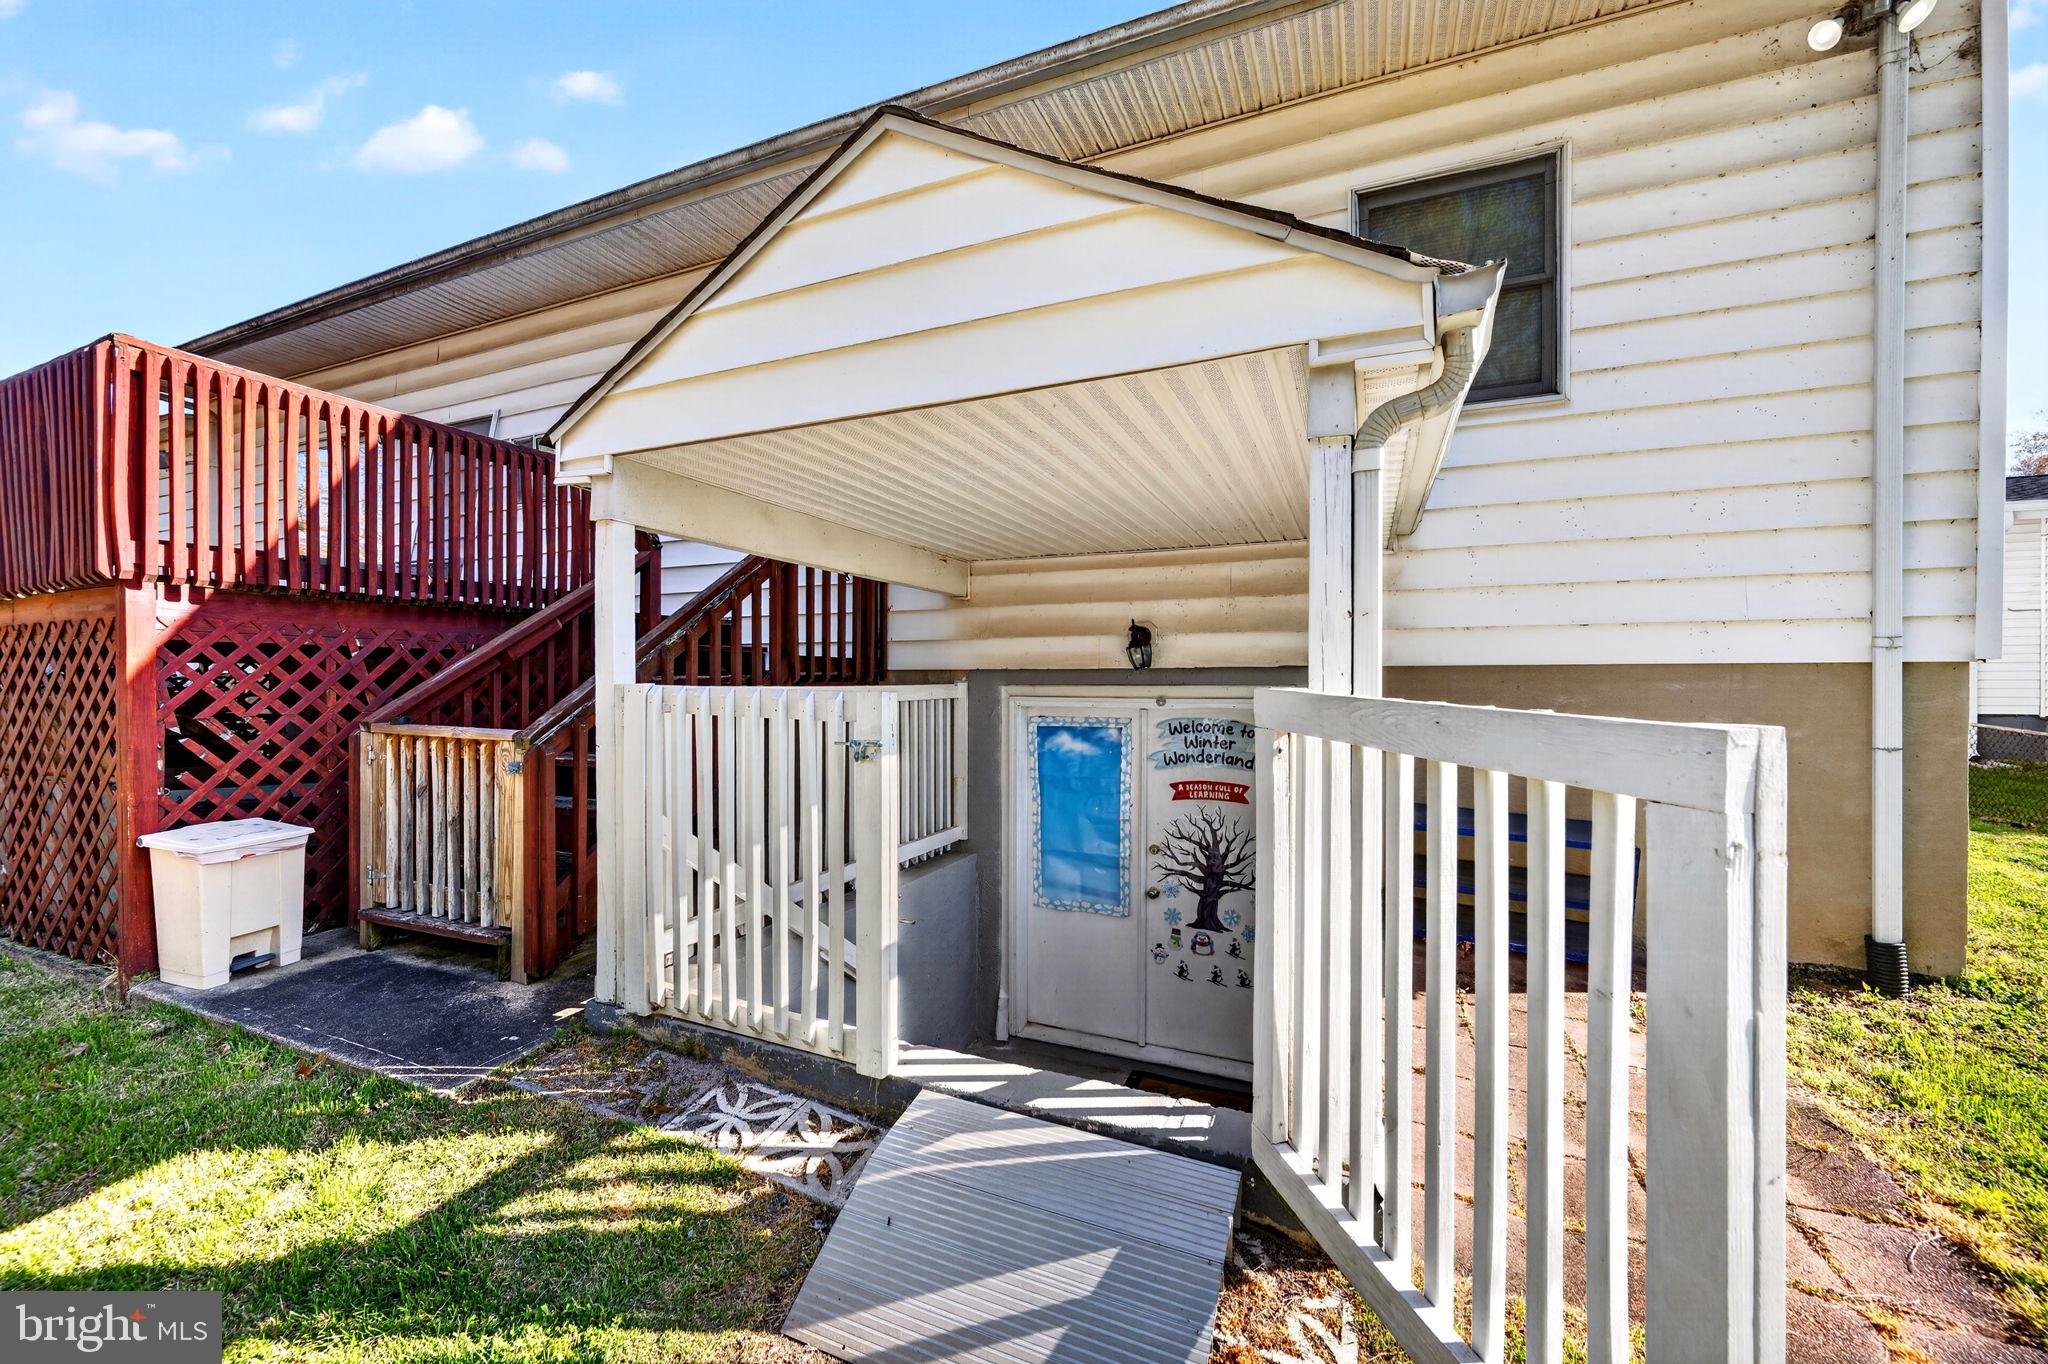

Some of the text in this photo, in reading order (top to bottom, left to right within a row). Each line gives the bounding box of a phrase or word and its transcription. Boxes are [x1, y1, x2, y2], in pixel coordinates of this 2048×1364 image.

[1168, 720, 1255, 739] Welcome to
[1184, 735, 1236, 750] Winter
[1163, 749, 1255, 770] Wonderland
[1189, 791, 1230, 800] LEARNING
[1215, 784, 1231, 792] FULL
[1234, 786, 1243, 794] OF
